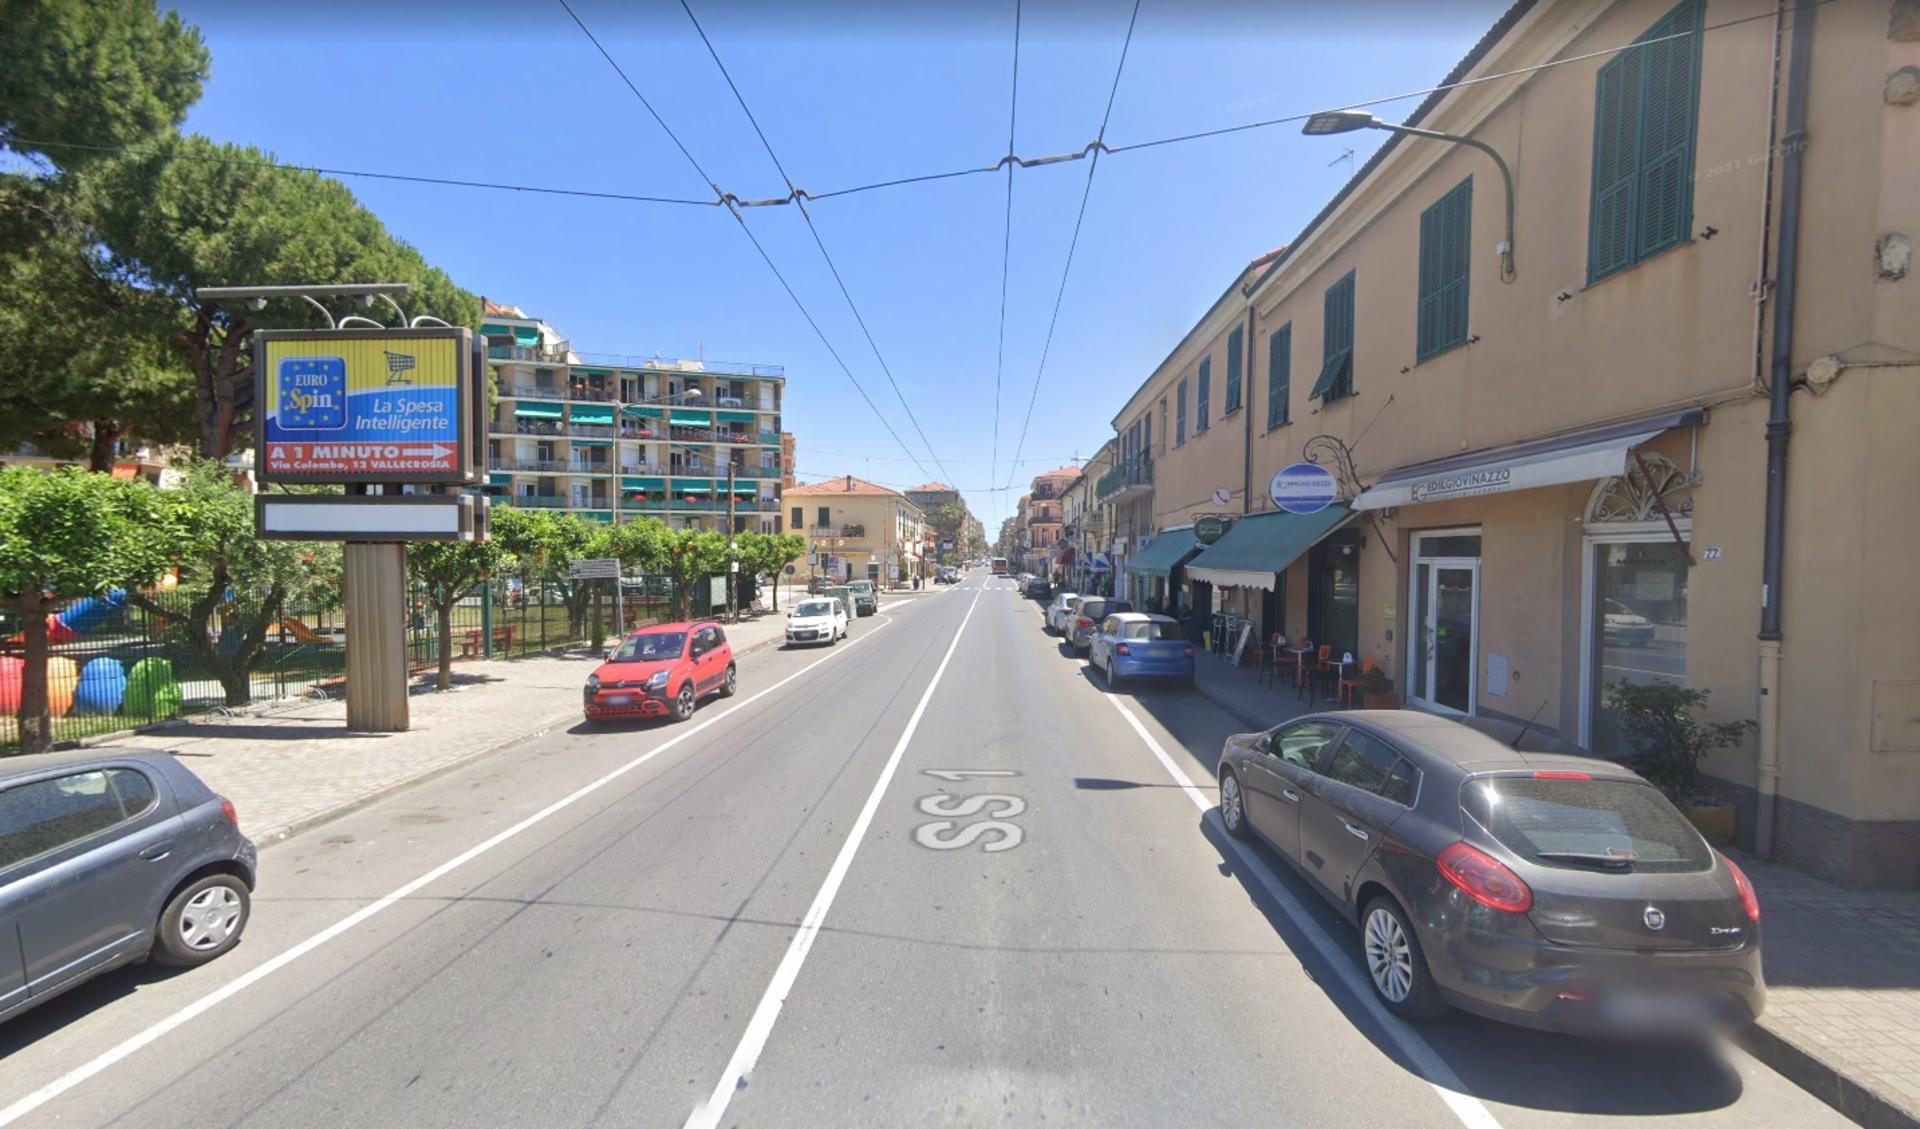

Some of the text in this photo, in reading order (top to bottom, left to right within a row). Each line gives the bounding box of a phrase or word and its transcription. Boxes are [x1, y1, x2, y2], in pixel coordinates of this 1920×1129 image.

[295, 374, 328, 387] EURO
[290, 388, 333, 415] Spin
[373, 398, 444, 417] La Spesa
[355, 414, 449, 434] Intelligente
[271, 445, 400, 459] A 1 MINUTO
[270, 460, 450, 471] Via Colombo, 12 VALLECROSIA
[1426, 468, 1511, 492] EDILGIOVINAZZO
[1705, 547, 1720, 560] 22
